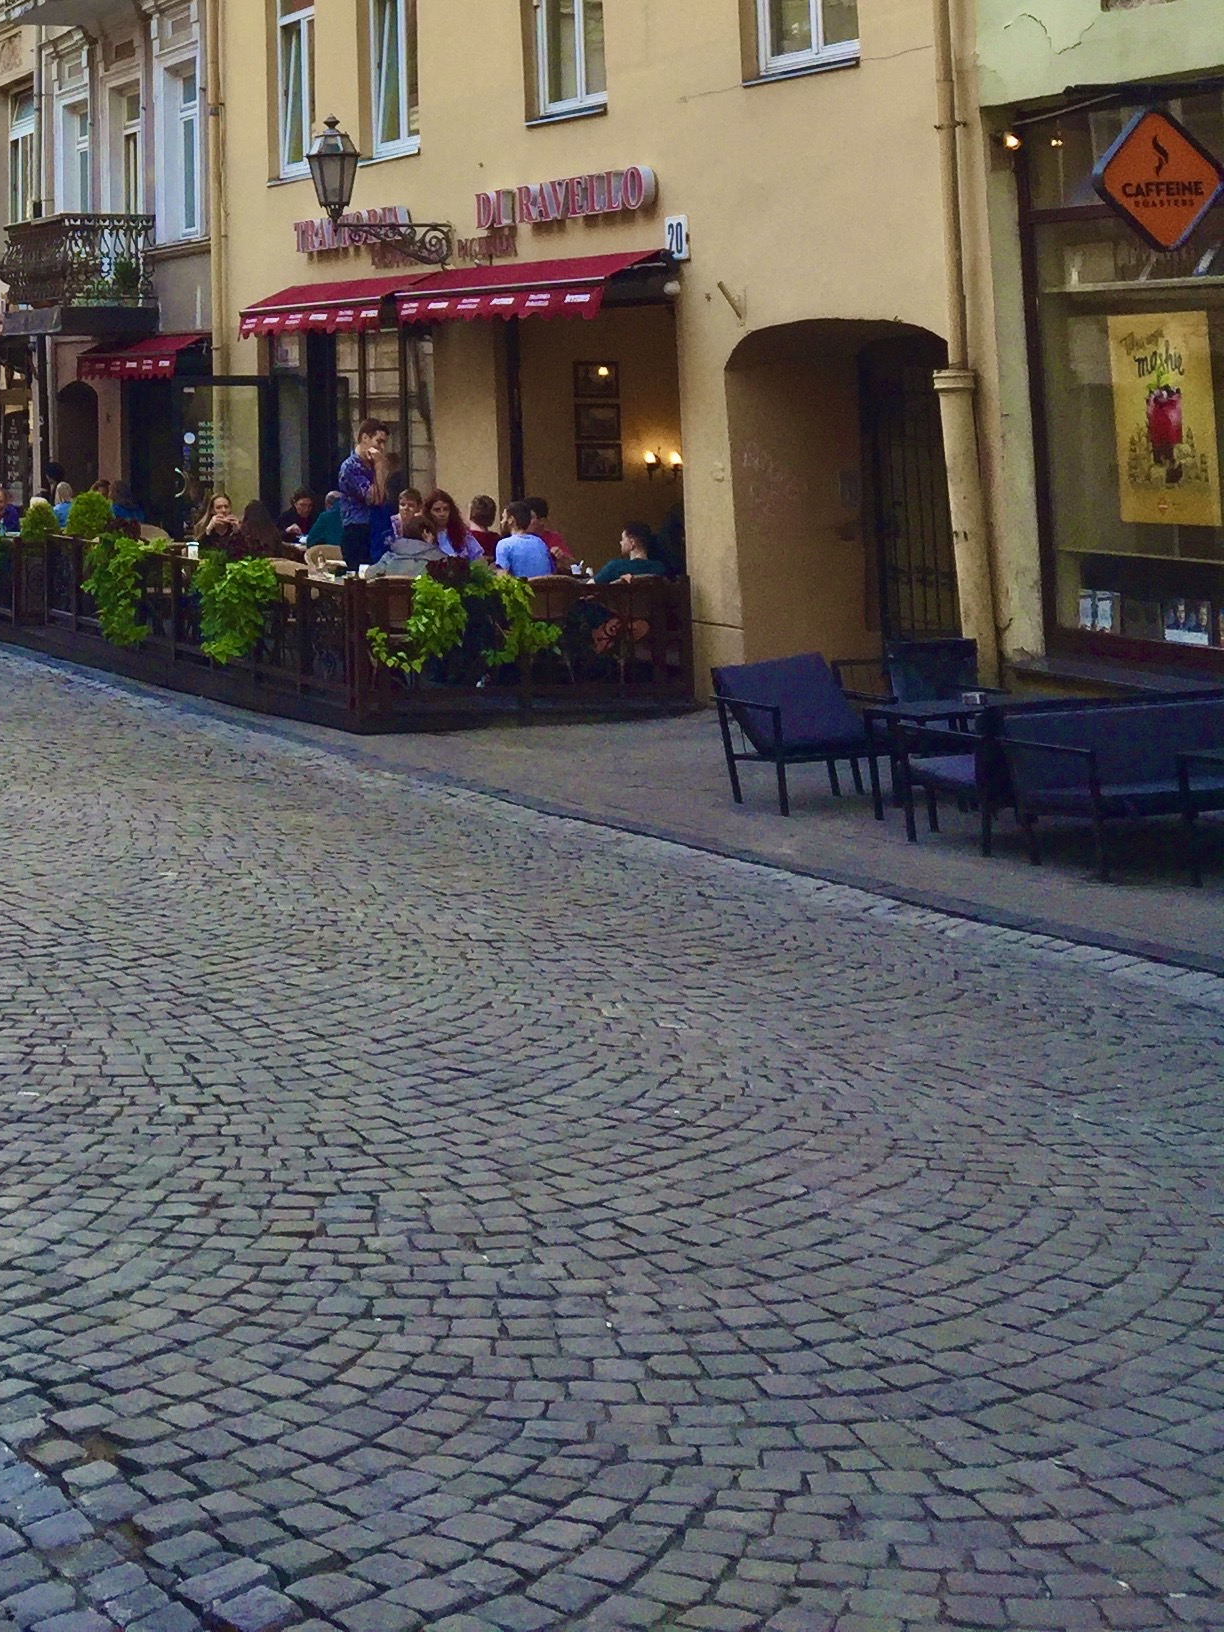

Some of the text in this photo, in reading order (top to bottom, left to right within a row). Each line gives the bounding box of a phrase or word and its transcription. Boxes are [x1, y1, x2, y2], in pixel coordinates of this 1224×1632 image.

[475, 189, 507, 230] DI
[516, 166, 650, 224] RAVELLO
[667, 221, 683, 255] 20
